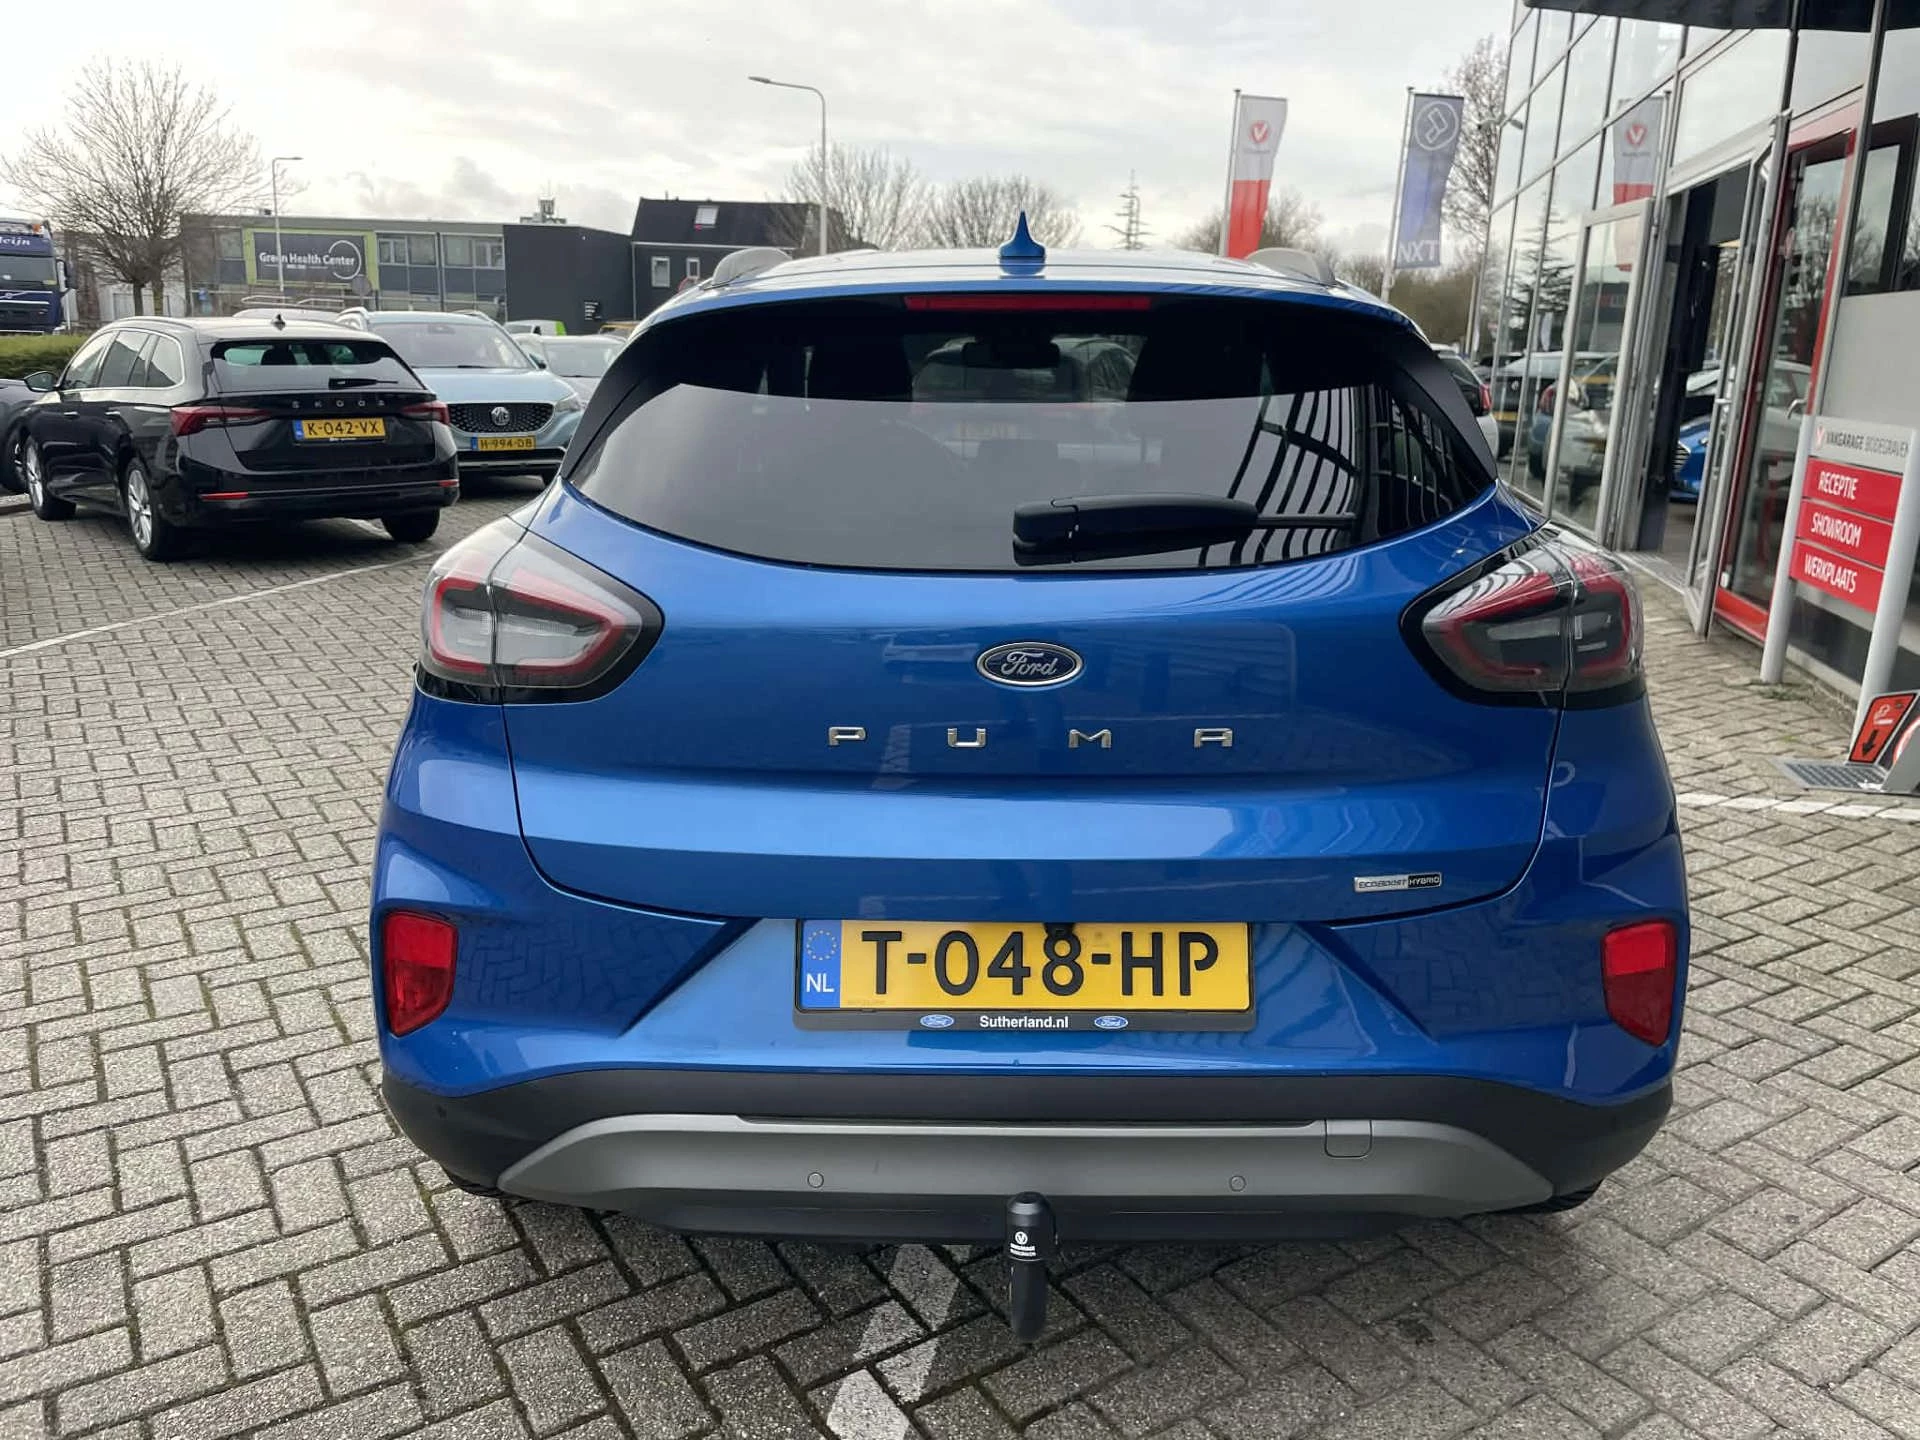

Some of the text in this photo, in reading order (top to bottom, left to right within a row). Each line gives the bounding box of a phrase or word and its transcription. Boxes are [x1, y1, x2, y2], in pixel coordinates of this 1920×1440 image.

[259, 252, 355, 266] Green Health Center
[1399, 240, 1440, 262] NXT
[307, 421, 378, 436] K-042-VX
[1818, 471, 1858, 500] RECEPTIE
[1811, 512, 1862, 548] SHOWROOM
[1804, 553, 1858, 593] WERKPLAATS
[1001, 651, 1058, 675] Ford
[828, 726, 1233, 748] PUMA
[1408, 875, 1440, 886] HYBRID
[861, 930, 1219, 996] T-048-HP
[806, 972, 835, 993] NL
[979, 1015, 1069, 1029] Sutherland.nl
